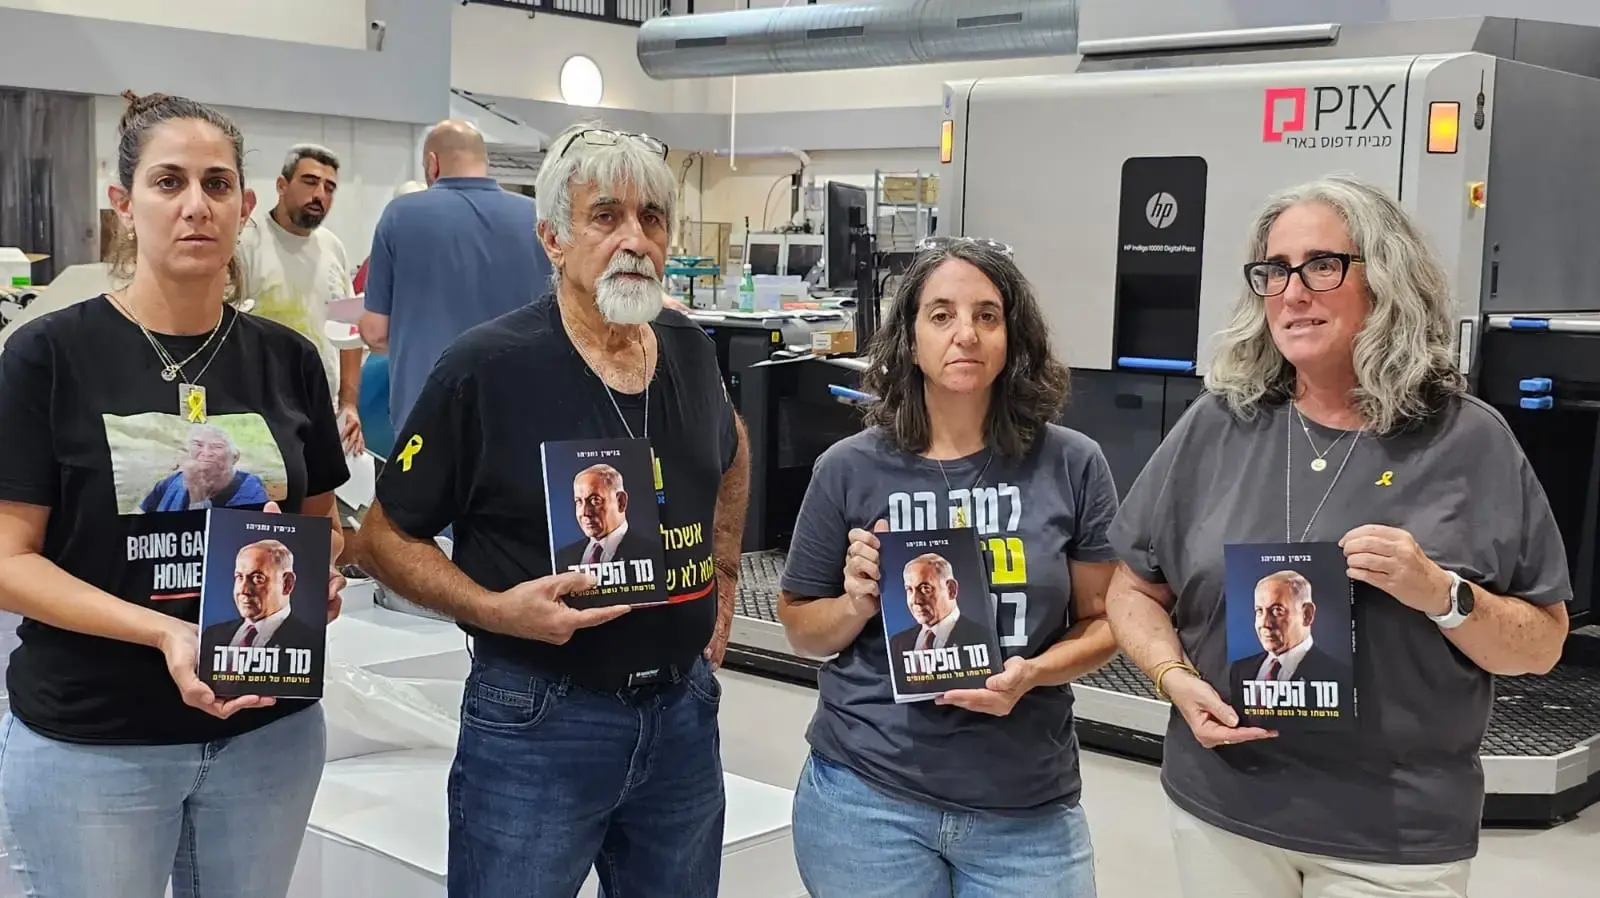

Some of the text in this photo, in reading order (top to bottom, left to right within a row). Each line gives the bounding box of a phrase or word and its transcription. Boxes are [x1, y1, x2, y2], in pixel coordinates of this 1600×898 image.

[1313, 84, 1396, 131] PIX
[1286, 135, 1392, 149] מבית דפוס בארי
[1149, 192, 1175, 228] hp
[1164, 244, 1181, 253] Digital
[888, 483, 1022, 534] למה הם
[127, 530, 206, 561] BRING GA
[660, 522, 703, 550] אשכול
[153, 562, 202, 590] HOME
[568, 558, 654, 586] מר הפק
[680, 558, 697, 588] לא
[213, 645, 311, 674] מר הפקרה
[902, 643, 990, 675] מר הפקרה
[1242, 680, 1306, 709] הפקרה
[1310, 681, 1339, 708] מר
